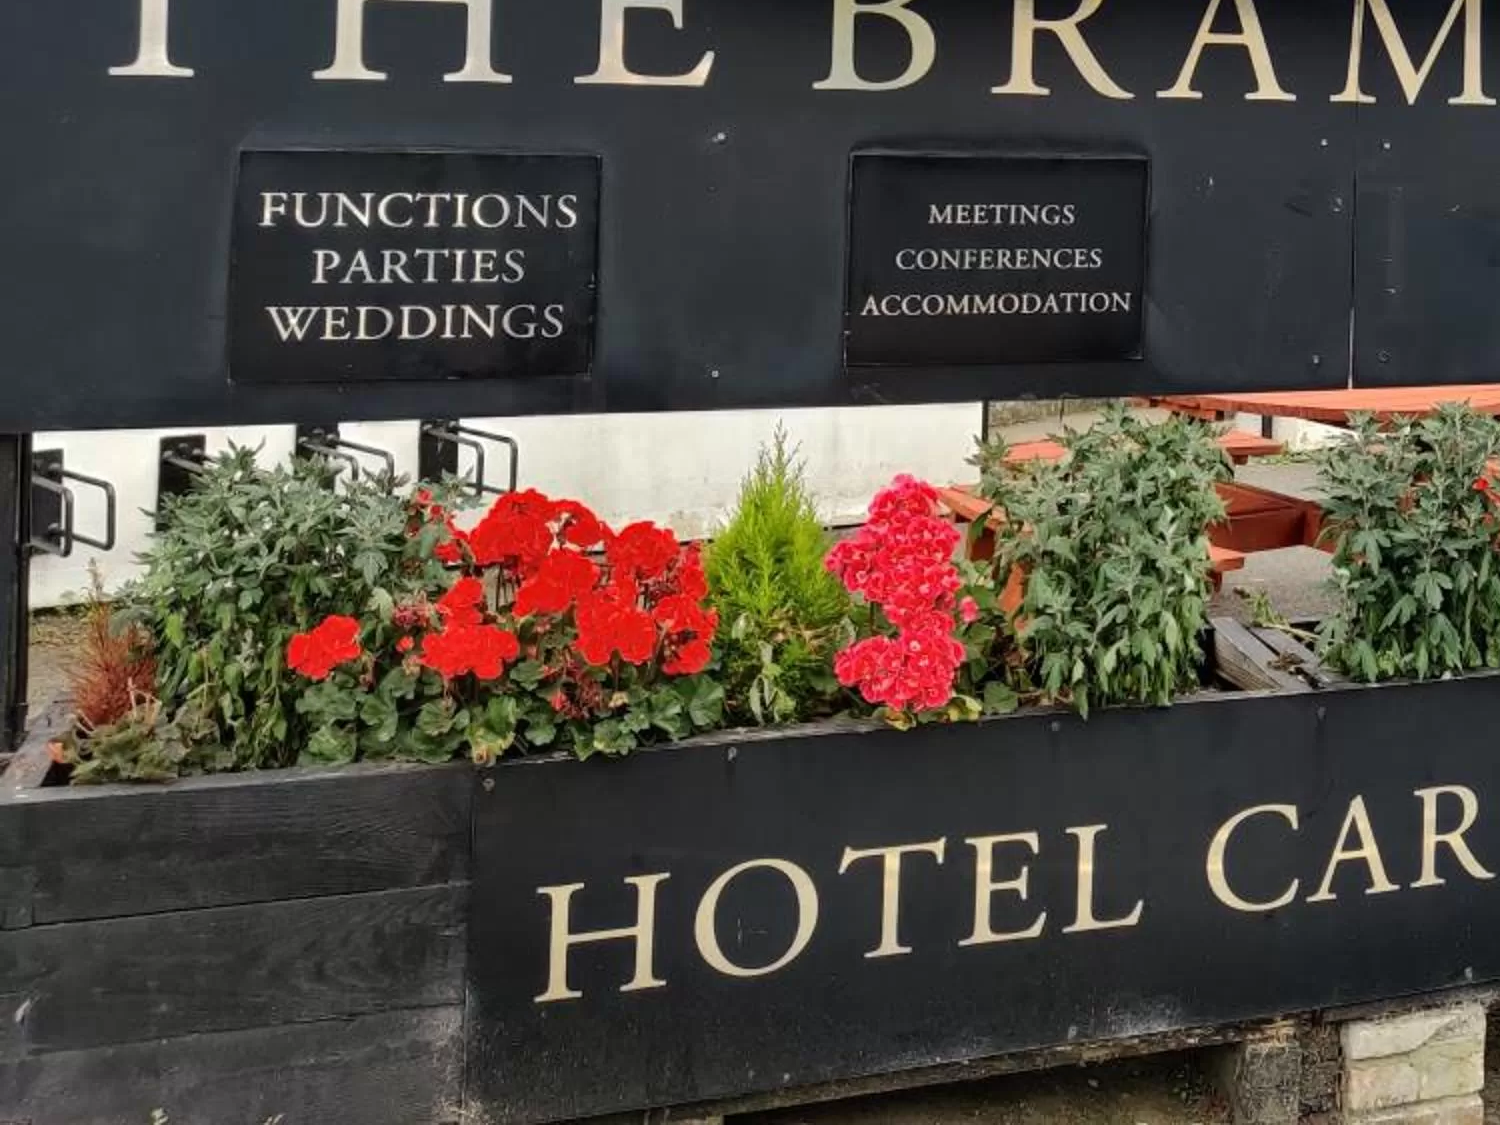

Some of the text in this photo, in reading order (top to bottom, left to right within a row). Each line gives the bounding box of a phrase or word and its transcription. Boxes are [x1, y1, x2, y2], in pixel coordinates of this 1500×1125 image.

[258, 190, 578, 230] FUNCTIONS
[928, 203, 1076, 226] MEETINGS
[311, 248, 526, 285] PARTIES
[895, 247, 1103, 271] CONFERENCES
[264, 303, 565, 342] WEDDINGS
[860, 290, 1132, 318] ACCOMMODATION
[534, 823, 1144, 1003] HOTEL
[1205, 784, 1496, 912] CAR
